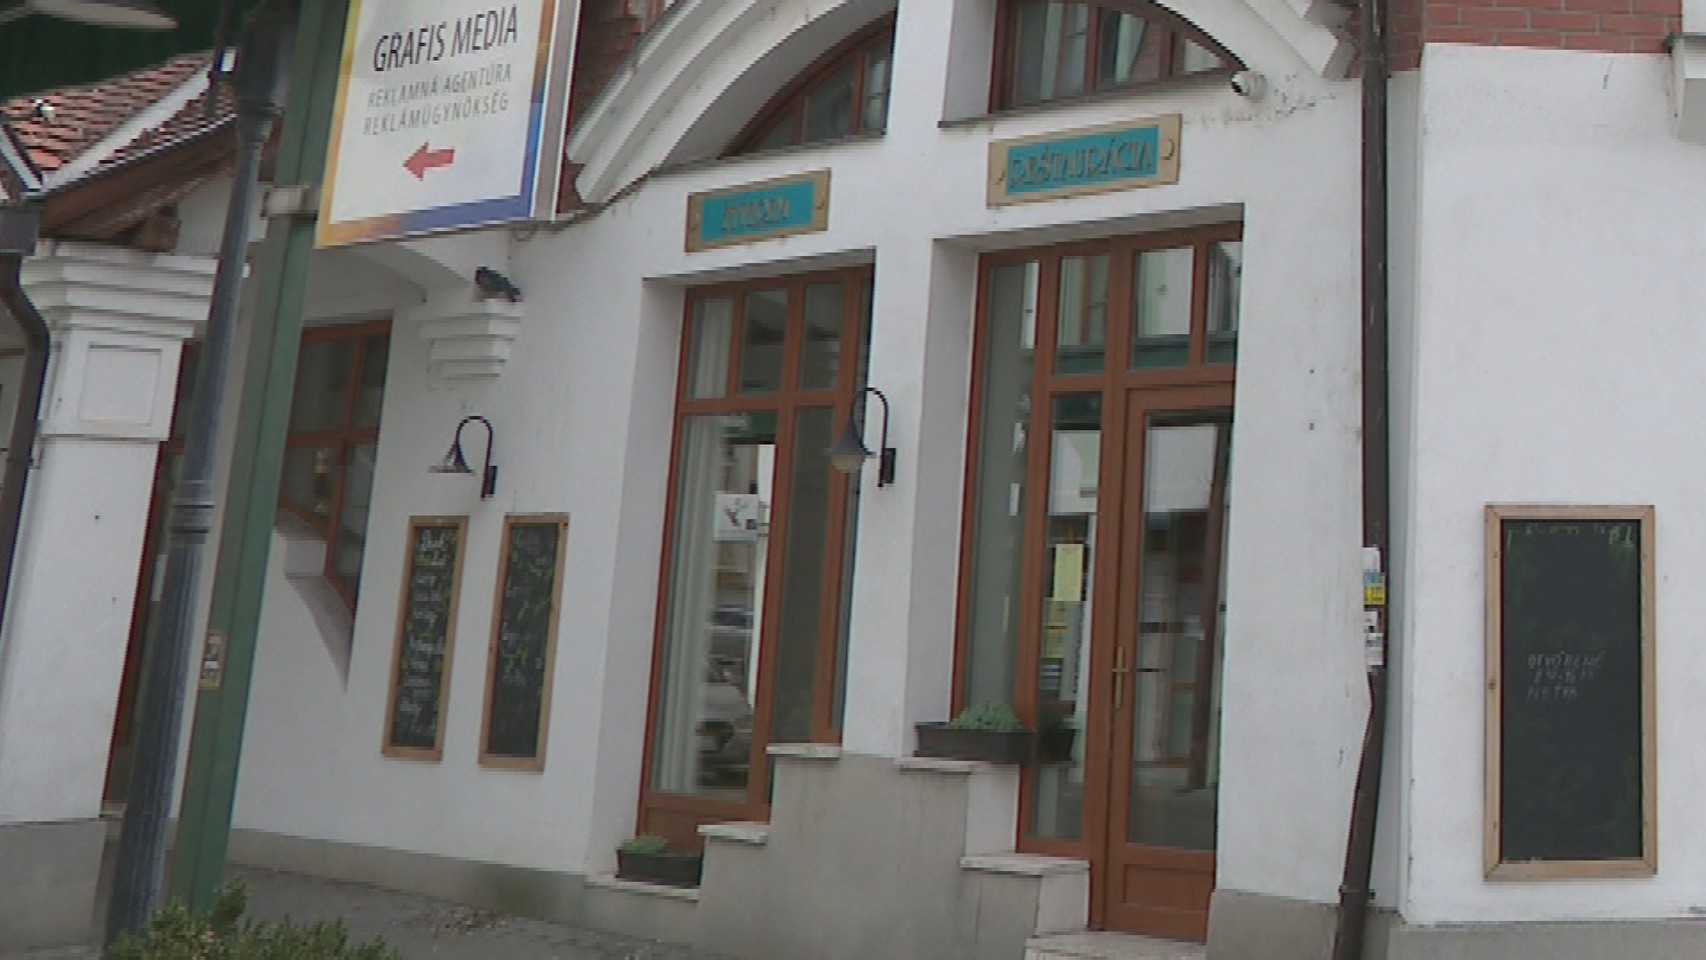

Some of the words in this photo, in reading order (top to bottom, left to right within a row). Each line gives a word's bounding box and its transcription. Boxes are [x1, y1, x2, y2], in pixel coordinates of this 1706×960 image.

[373, 20, 447, 72] GRAFIS
[450, 4, 518, 58] MEDIA
[367, 74, 439, 110] REKLAMNÁ
[443, 63, 512, 96] AGENTÚRA
